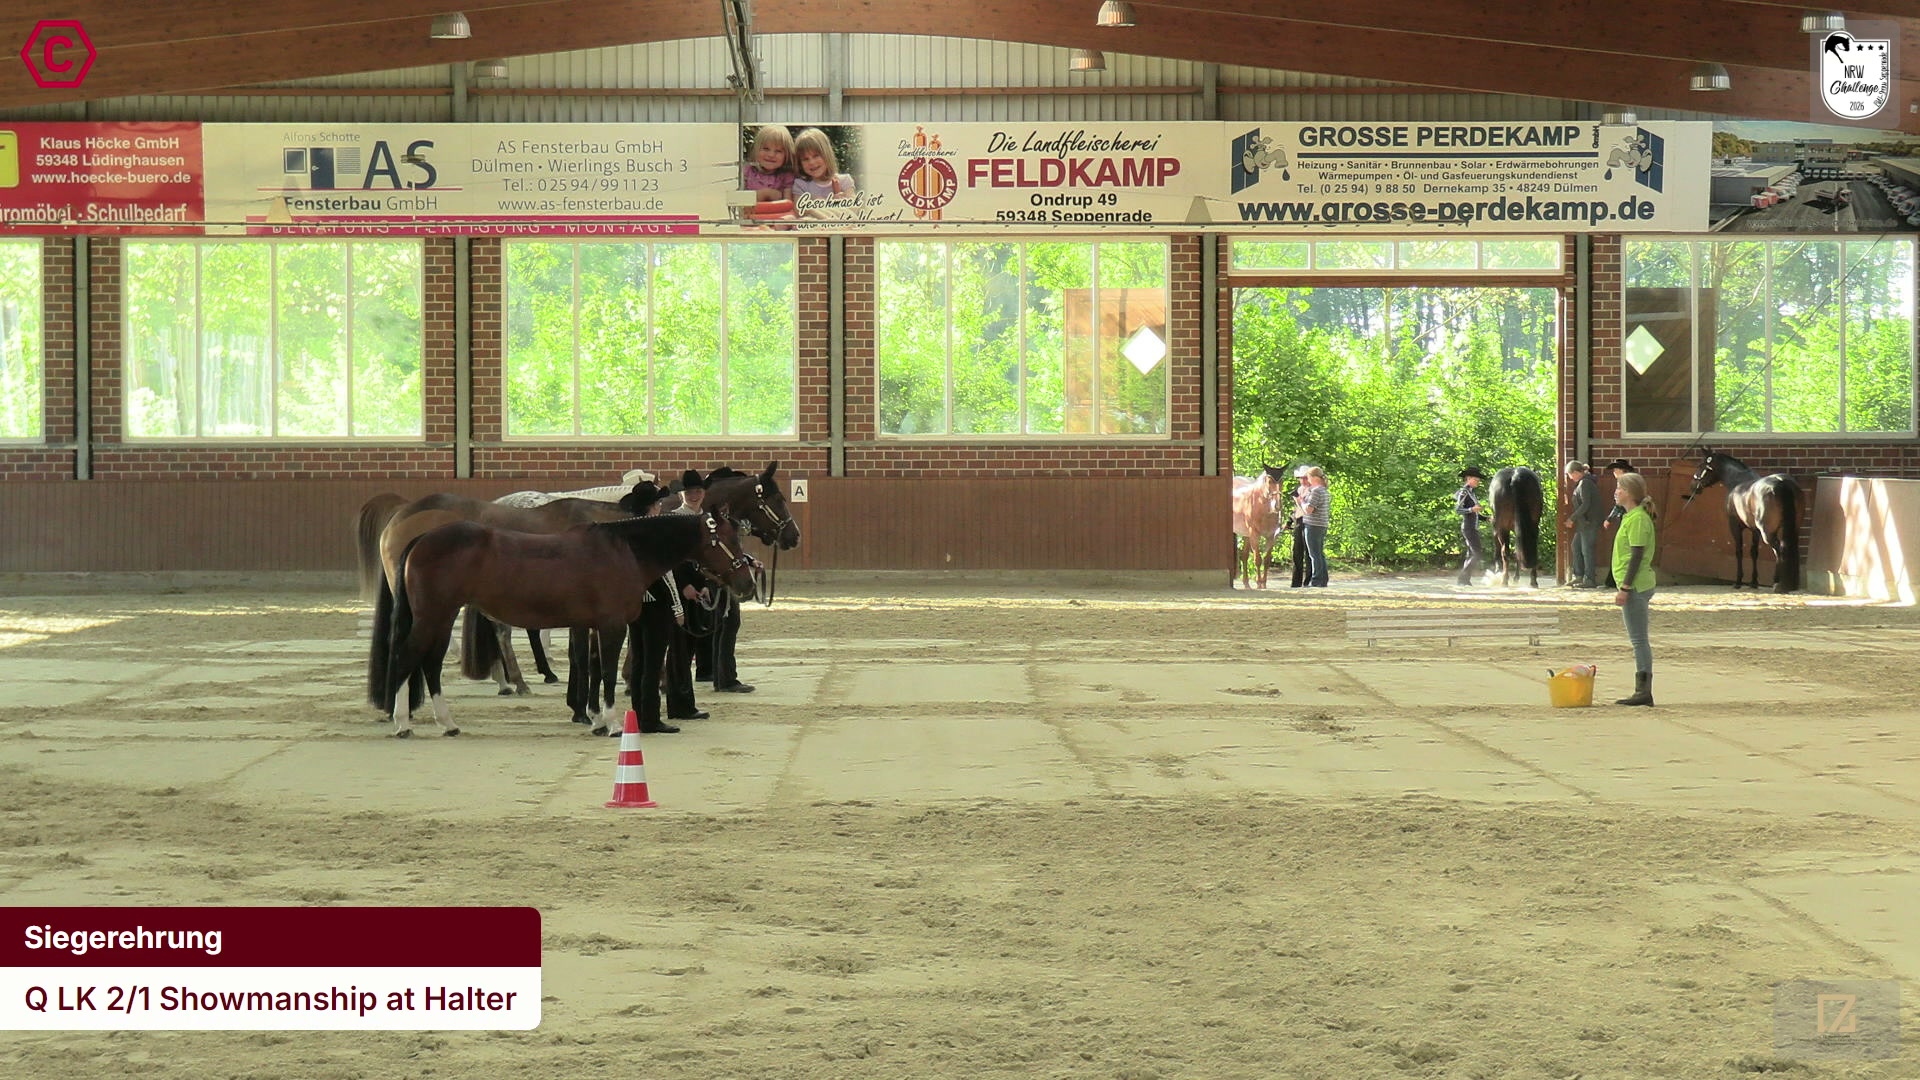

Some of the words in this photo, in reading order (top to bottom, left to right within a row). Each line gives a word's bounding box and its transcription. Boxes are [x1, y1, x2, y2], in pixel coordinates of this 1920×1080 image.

[40, 137, 81, 149] Klaus
[85, 136, 131, 149] Höcke
[134, 137, 180, 149] GmbH
[284, 132, 316, 142] Alfons
[319, 132, 361, 142] Schotte
[1298, 126, 1409, 147] GROSSE
[1416, 126, 1581, 147] PERDEKAMP
[1592, 126, 1600, 149] GmbH
[497, 141, 516, 154] AS
[522, 140, 609, 154] Fensterbau
[615, 140, 664, 154] GmbH
[988, 131, 1018, 154] Die
[1022, 130, 1162, 160] Landfleischerei
[36, 154, 79, 167] 59348
[82, 153, 185, 169] Lüdinghausen
[362, 140, 438, 189] AS
[472, 158, 534, 173] Dülmen
[548, 159, 620, 176] Wierlings
[626, 159, 673, 173] Busch
[679, 159, 688, 173] 3
[1297, 160, 1338, 171] Heizung
[1346, 160, 1382, 169] Sanitär
[1390, 160, 1452, 169] Brunnenbau
[1460, 160, 1487, 169] Solar
[1495, 160, 1599, 171] Erdwärmebohrungen
[32, 171, 192, 184] www.hoecke-buero.de
[968, 158, 1181, 188] FELDKAMP
[1318, 171, 1393, 181] Wärmepumpen
[1403, 170, 1418, 180] Öl-
[1420, 171, 1439, 180] und
[1442, 171, 1578, 181] Gasfeuerungskundendienst
[503, 178, 533, 192] Tel.:
[1297, 183, 1317, 194] Tel.
[1423, 183, 1489, 195] Dernekamp
[1492, 183, 1506, 193] 35
[1516, 183, 1550, 193] 48249
[1554, 182, 1598, 193] Dülmen
[900, 178, 956, 209] FELDKAMP
[1031, 193, 1093, 209] Ondrup
[1098, 193, 1118, 206] 49
[284, 196, 381, 211] Fensterbau
[386, 196, 438, 211] GmbH
[498, 196, 664, 211] www.as-fensterbau.de
[797, 191, 864, 215] Geschmack
[866, 193, 884, 207] ist
[0, 203, 72, 222] romöbel
[87, 203, 187, 222] Schulbedarf
[996, 210, 1047, 222] 59348
[1051, 210, 1153, 222] Seppenrade
[1238, 196, 1655, 228] www.grosse-perdekamp.de
[794, 485, 805, 497] A
